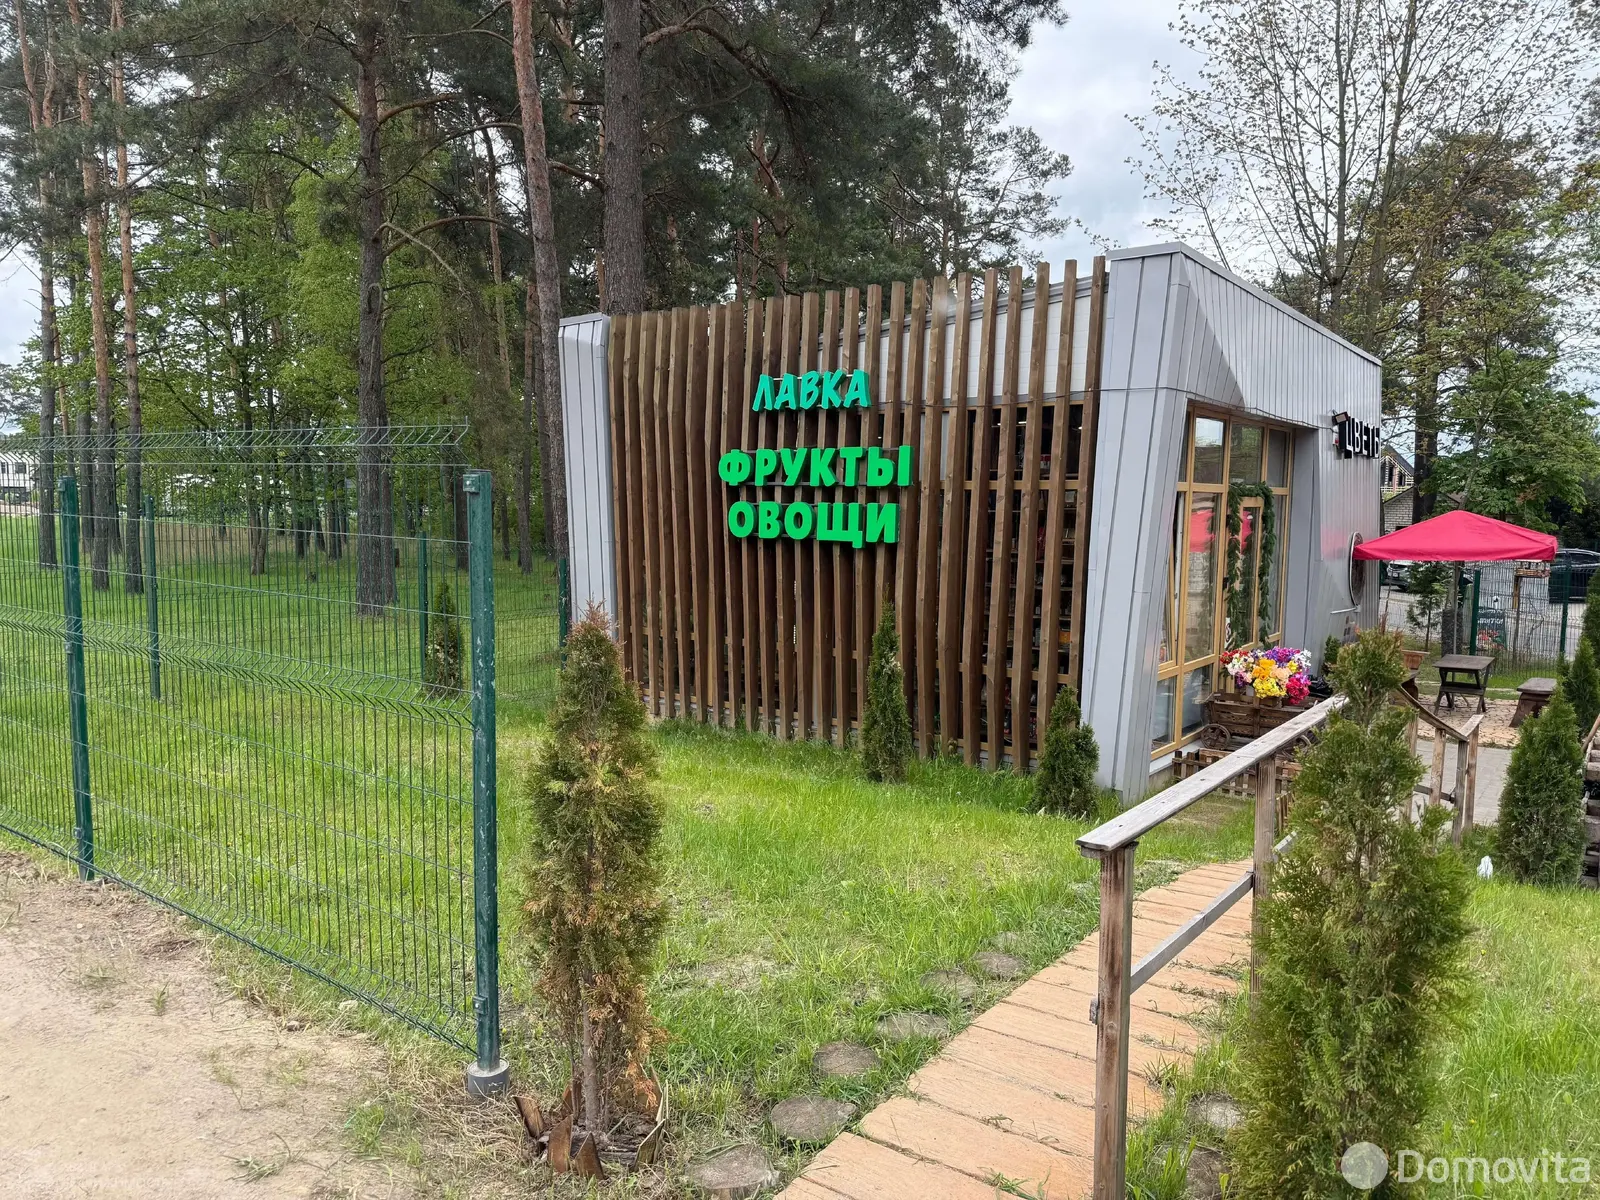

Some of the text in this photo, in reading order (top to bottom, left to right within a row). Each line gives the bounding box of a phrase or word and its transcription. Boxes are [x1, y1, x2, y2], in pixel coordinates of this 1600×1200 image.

[752, 369, 871, 412] ЛАВКА
[718, 445, 913, 487] ФРУКТЫ
[728, 501, 899, 548] ОВОЩИ
